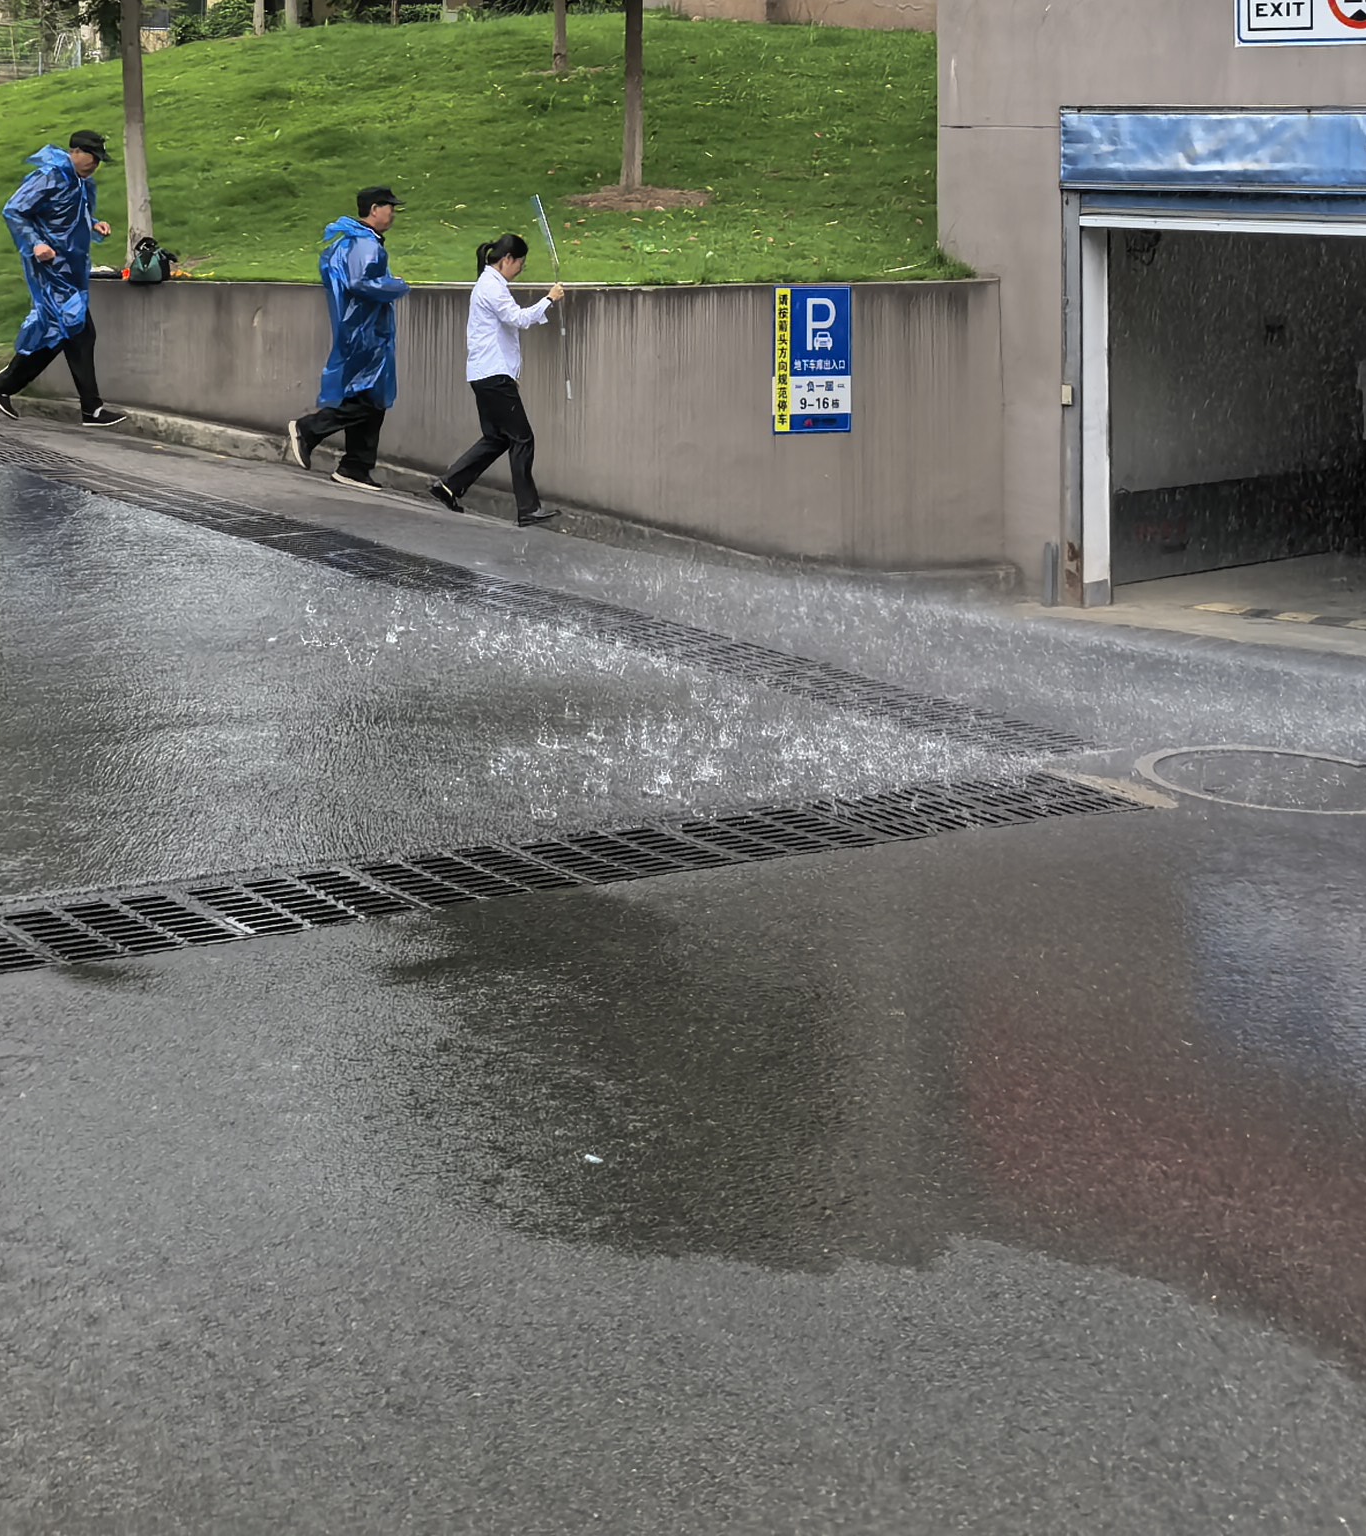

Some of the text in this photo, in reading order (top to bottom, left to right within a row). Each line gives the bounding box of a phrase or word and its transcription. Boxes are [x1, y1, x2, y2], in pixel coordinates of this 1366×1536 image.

[1255, 1, 1305, 17] EXIT
[806, 297, 836, 351] P
[794, 359, 846, 371] 地下车库出入口
